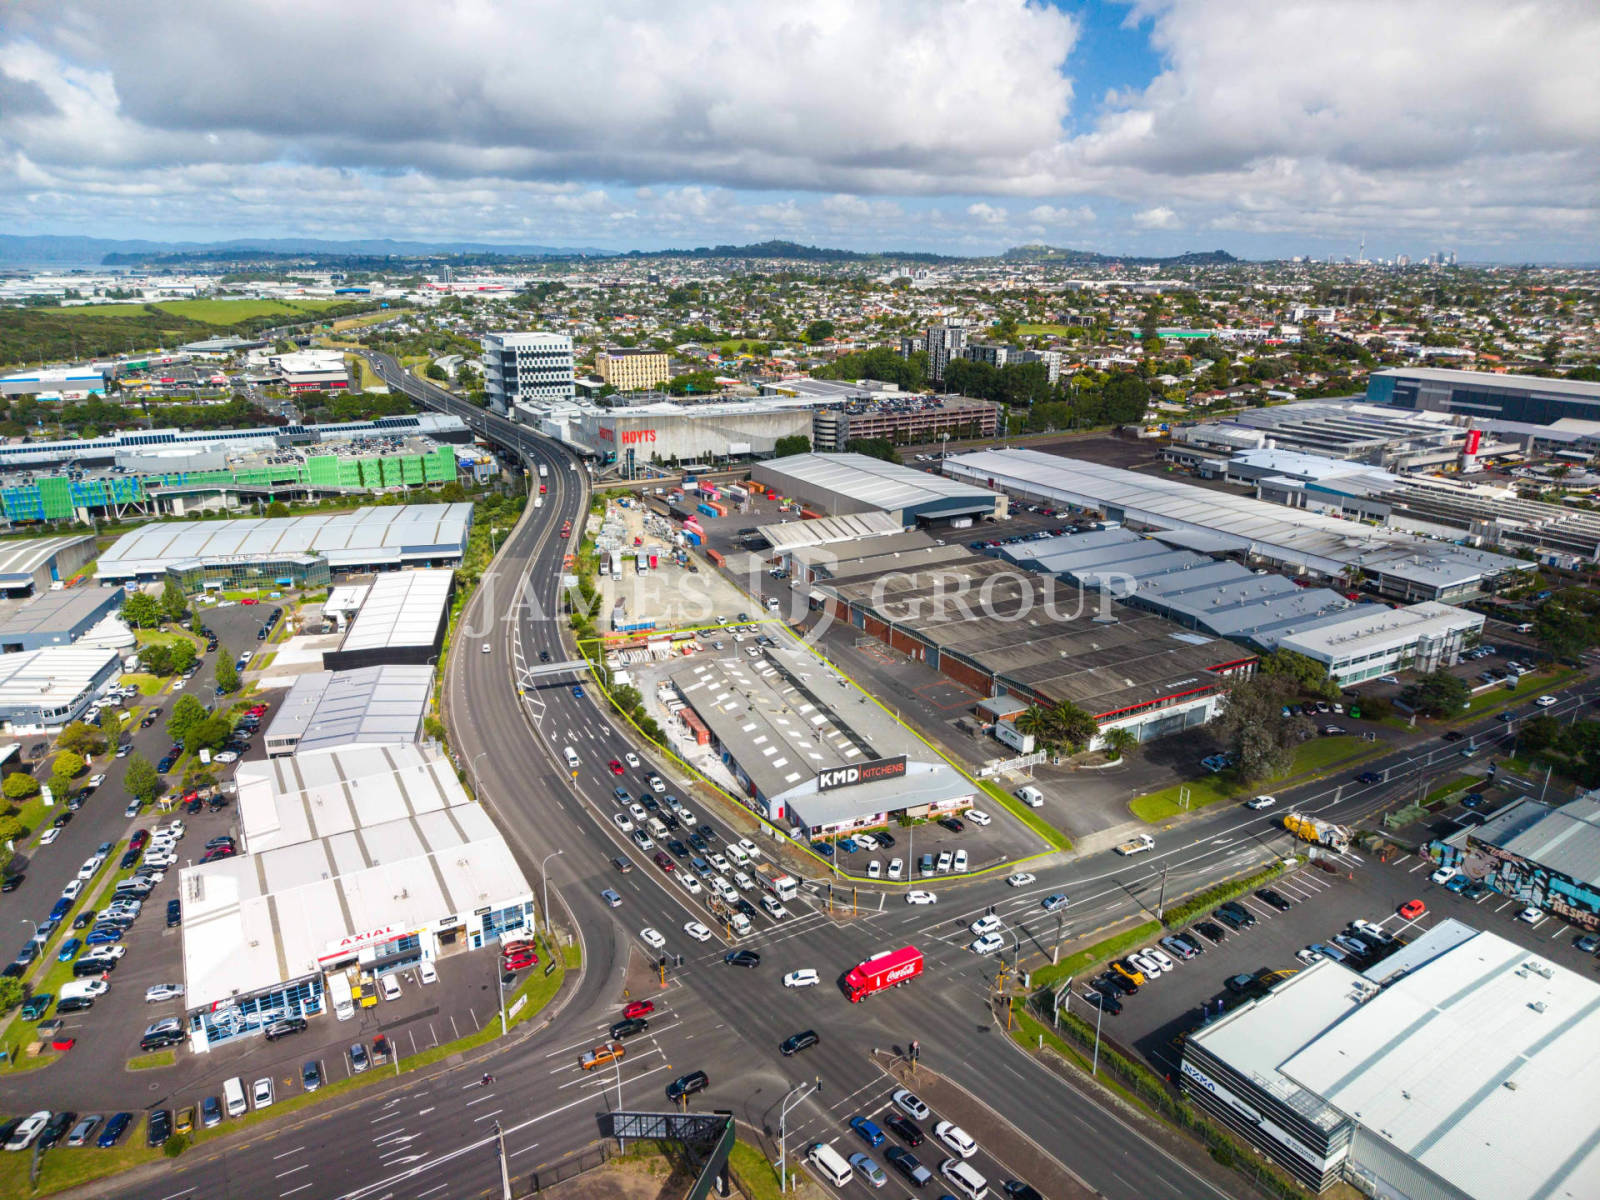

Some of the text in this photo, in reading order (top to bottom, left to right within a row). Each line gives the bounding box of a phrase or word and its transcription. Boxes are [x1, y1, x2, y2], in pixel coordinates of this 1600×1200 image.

[621, 430, 656, 444] HOYTS
[820, 763, 904, 787] KMD KITCHENS
[1552, 900, 1600, 926] RESPECT
[340, 927, 394, 946] AXIAL
